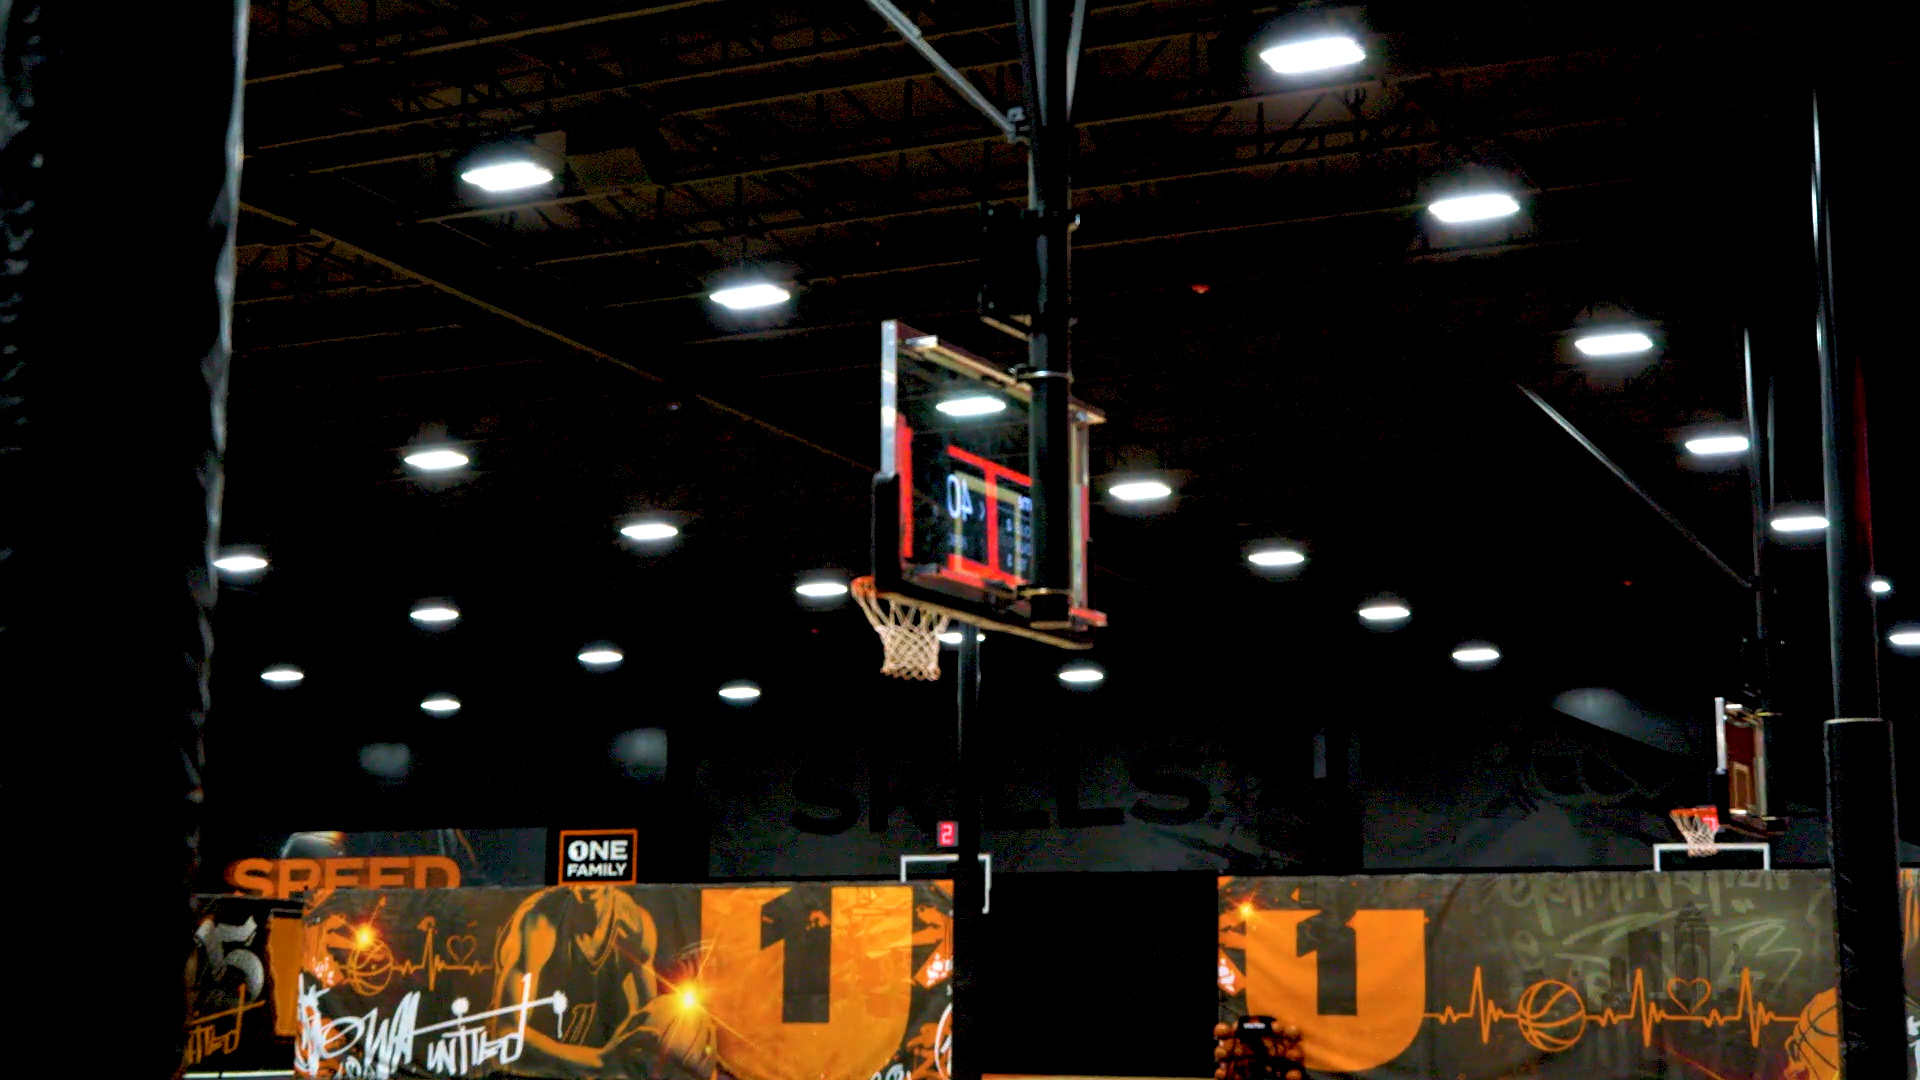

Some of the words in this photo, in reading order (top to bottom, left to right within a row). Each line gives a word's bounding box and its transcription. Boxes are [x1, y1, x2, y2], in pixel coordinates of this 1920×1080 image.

[790, 752, 1212, 828] SKLLS
[941, 824, 955, 845] 2
[568, 840, 628, 861] ONE
[228, 855, 461, 899] SPEED
[567, 862, 627, 877] FAMILY
